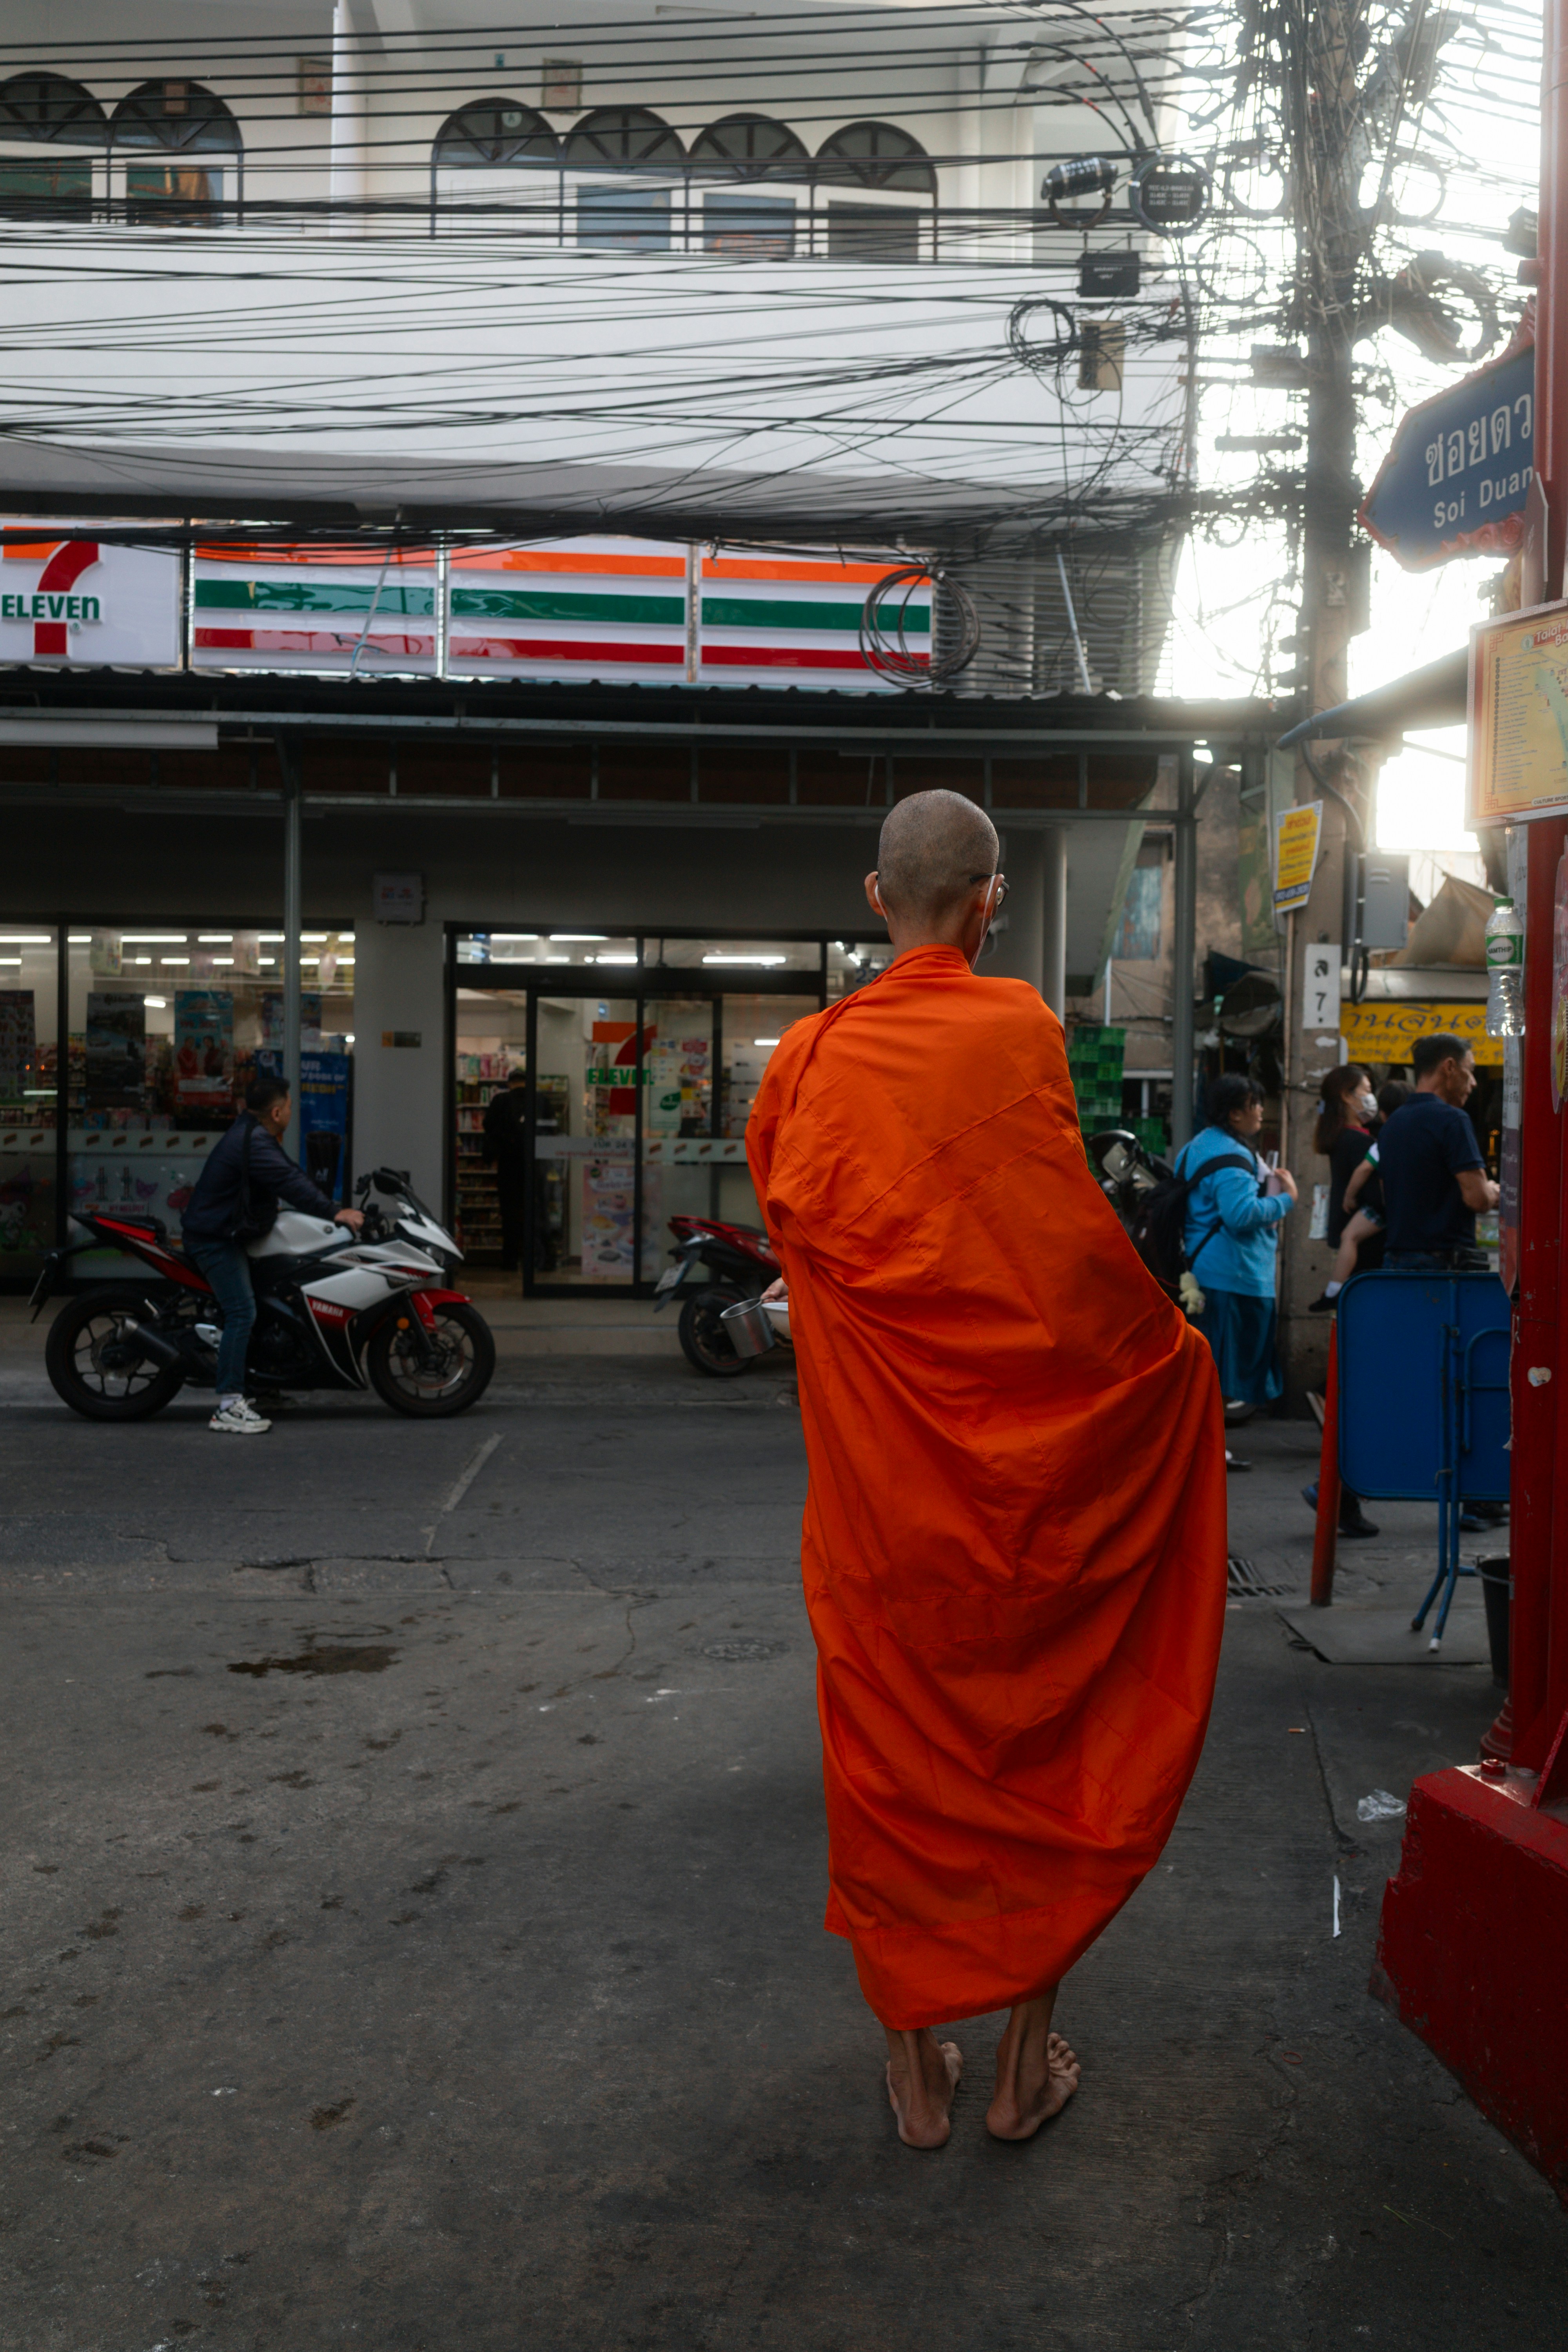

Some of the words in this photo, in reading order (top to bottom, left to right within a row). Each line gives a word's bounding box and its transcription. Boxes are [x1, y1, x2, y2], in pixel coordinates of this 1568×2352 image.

[1434, 491, 1465, 528] Soi
[1536, 621, 1562, 642] Talat
[312, 1299, 344, 1318] YAMAHA
